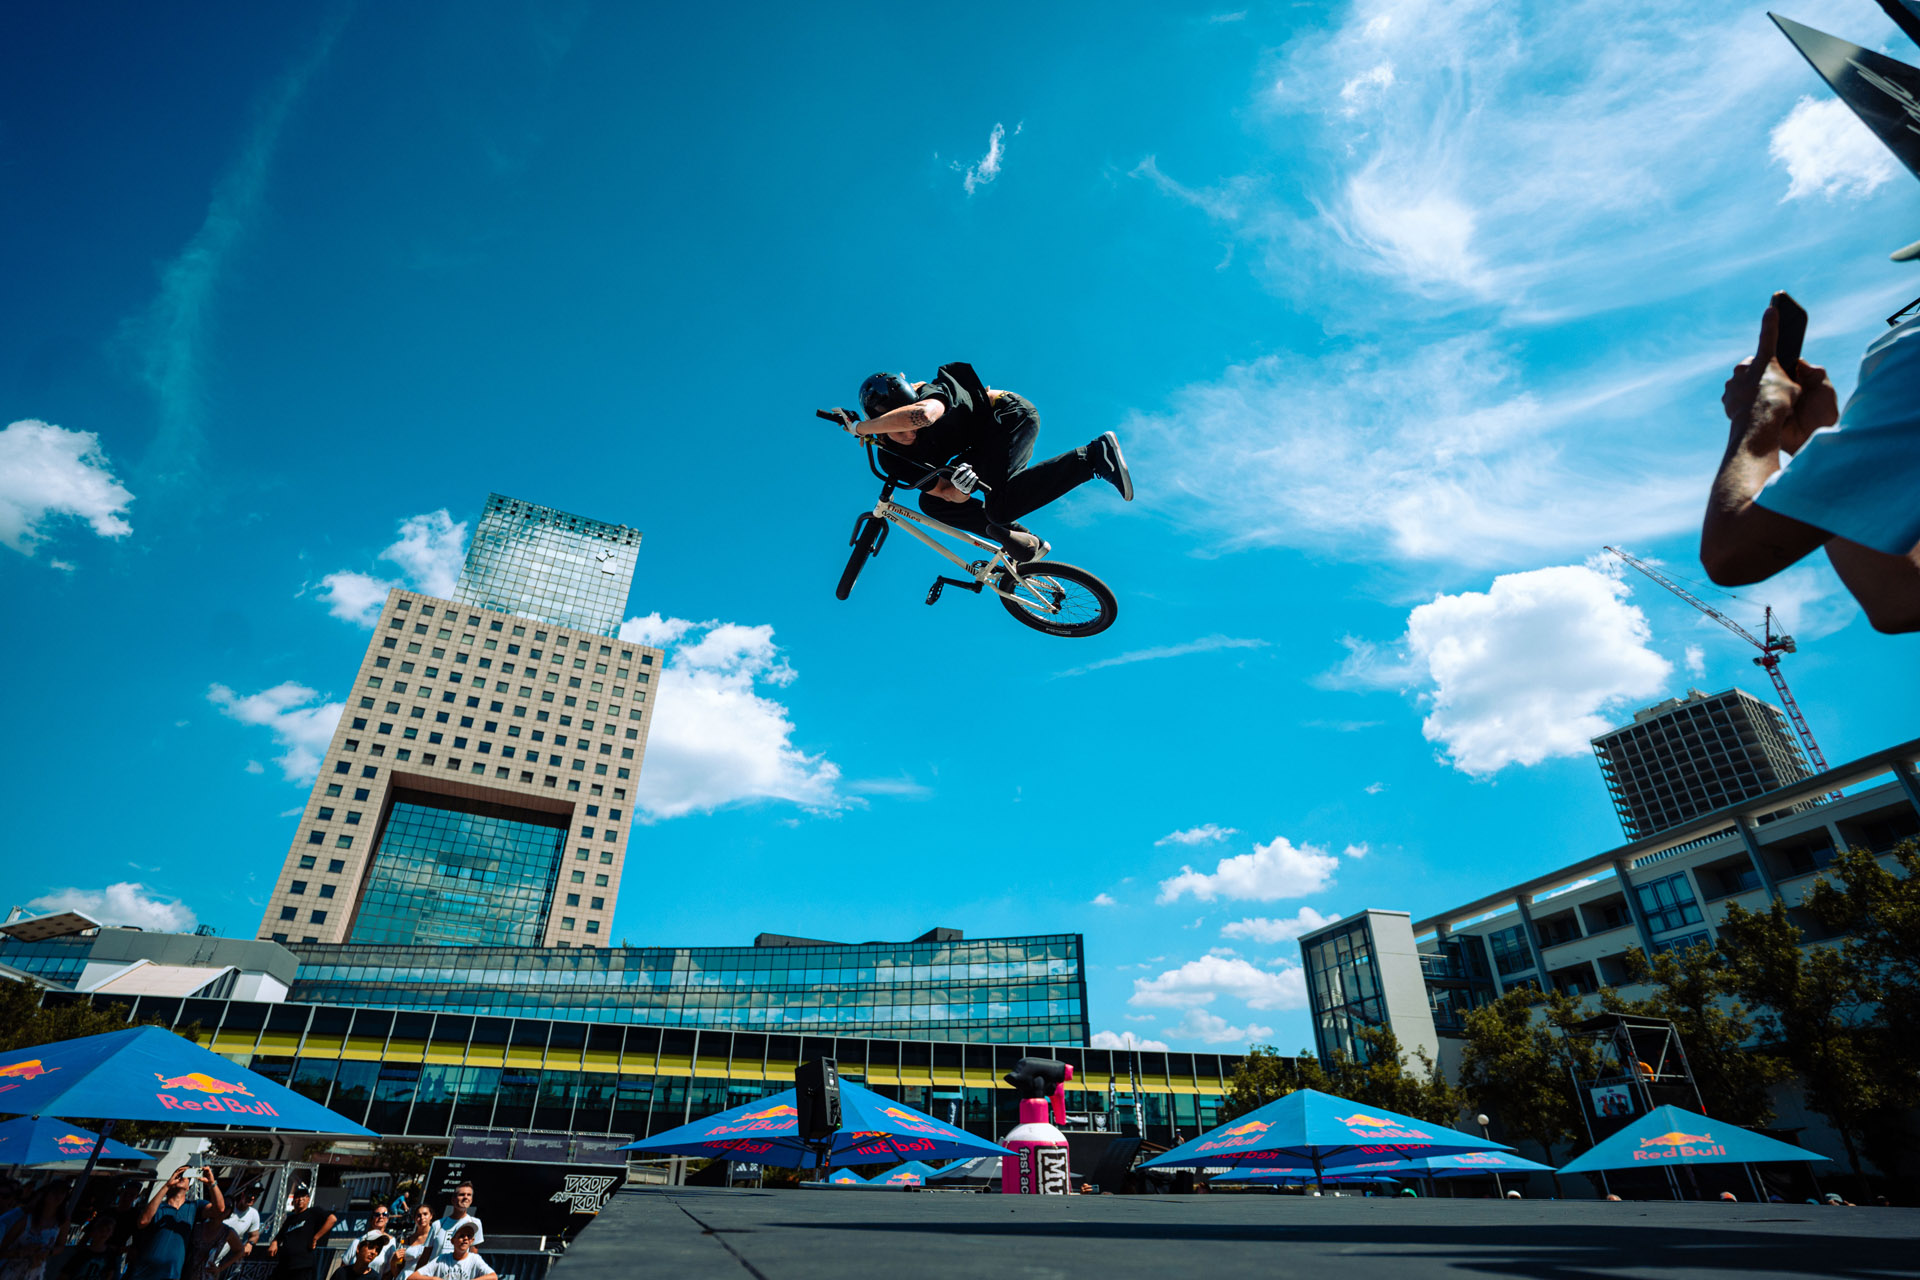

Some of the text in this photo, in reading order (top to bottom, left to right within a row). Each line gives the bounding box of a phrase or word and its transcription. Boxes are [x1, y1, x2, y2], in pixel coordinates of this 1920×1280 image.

[156, 1093, 280, 1117] Red Bull
[703, 1119, 799, 1136] Red Bull
[1348, 1127, 1434, 1139] Red Bull
[58, 1146, 90, 1155] Red
[1195, 1134, 1265, 1152] Red Bull
[1632, 1145, 1727, 1161] Red Bull
[564, 1174, 618, 1195] DROP
